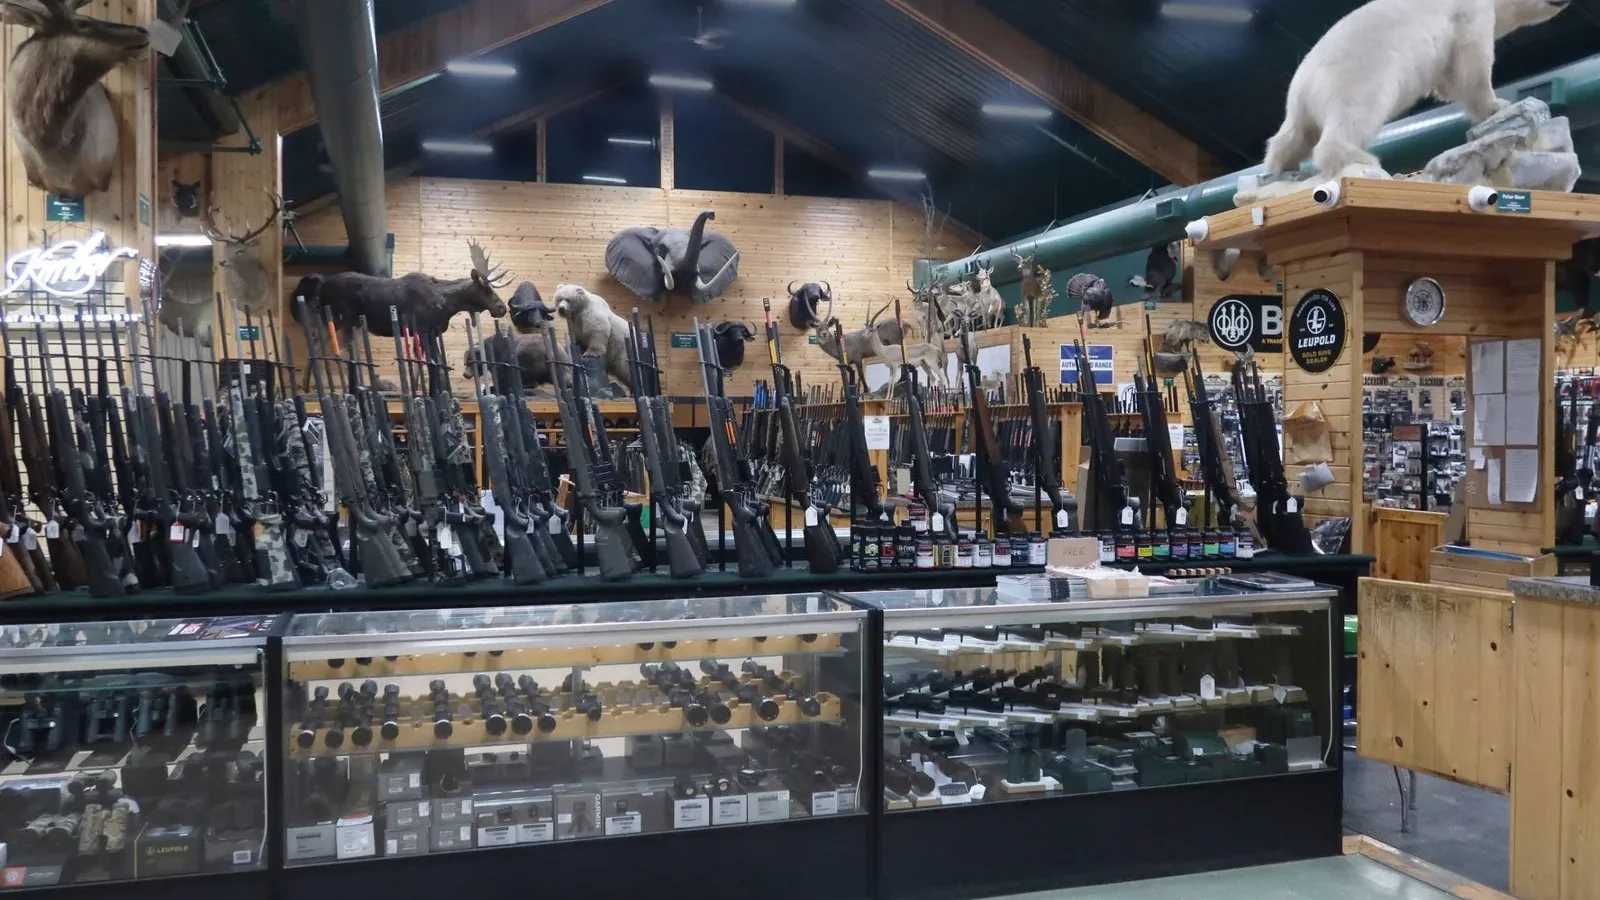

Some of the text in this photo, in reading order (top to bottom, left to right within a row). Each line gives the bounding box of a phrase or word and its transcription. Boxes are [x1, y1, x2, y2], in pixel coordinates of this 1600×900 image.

[1298, 334, 1336, 348] LEUPOLD
[1094, 361, 1112, 369] RANGE
[1062, 546, 1087, 557] FREE
